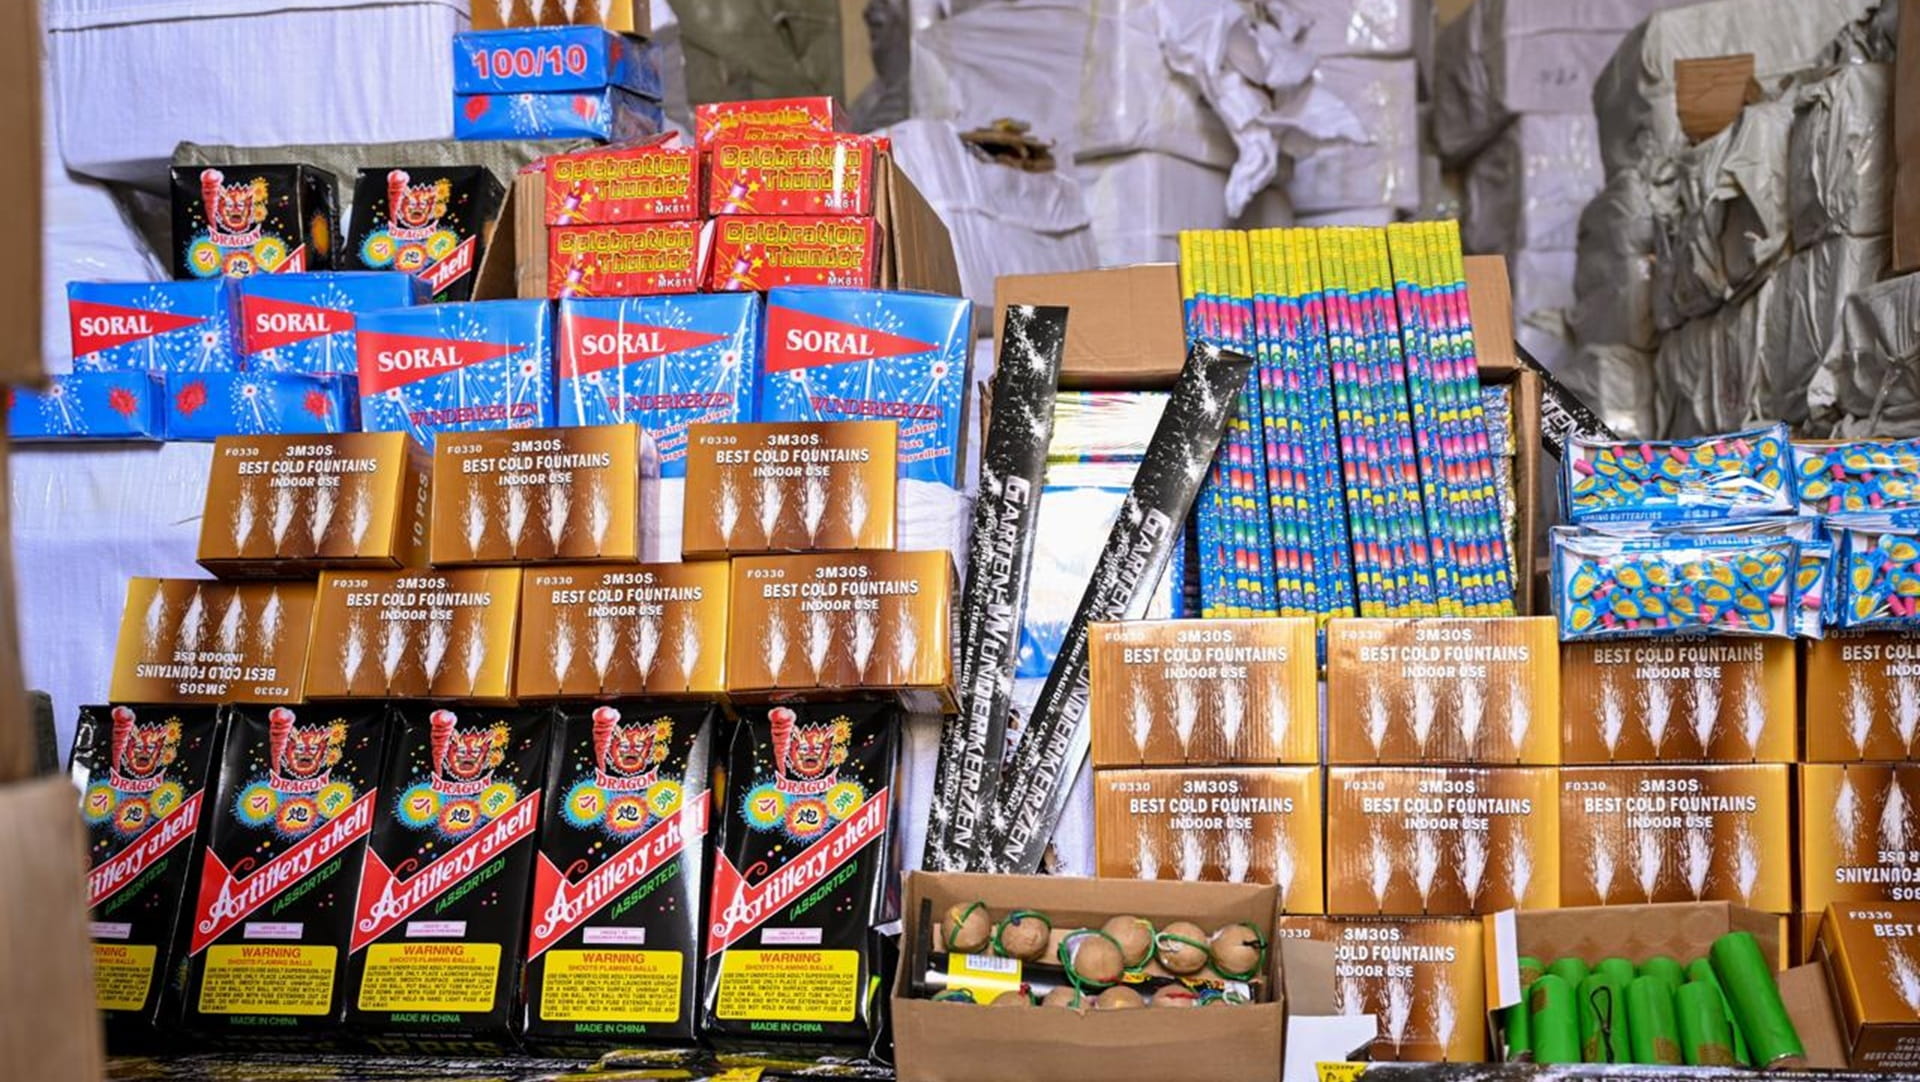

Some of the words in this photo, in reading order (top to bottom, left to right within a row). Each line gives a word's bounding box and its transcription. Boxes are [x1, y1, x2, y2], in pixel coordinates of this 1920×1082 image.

[473, 46, 587, 78] 100/10
[555, 157, 690, 180] Celebration
[597, 178, 687, 199] Thunder
[211, 230, 260, 246] DRAGON
[389, 224, 437, 239] DRAGON
[726, 223, 864, 245] Celebration
[559, 231, 693, 253] Celebration
[600, 253, 690, 273] Thunder
[767, 246, 862, 268] Thunder
[80, 316, 152, 336] SORAL
[256, 314, 330, 332] SORAL
[582, 332, 665, 355] SORAL
[786, 329, 874, 355] SORAL
[378, 347, 462, 372] SORAL
[512, 439, 562, 452] 3M30S
[768, 435, 819, 446] 3M30S
[286, 446, 333, 456] 3M30S
[716, 452, 750, 464] BEST
[753, 451, 789, 463] COLD
[793, 449, 869, 462] FOUNTAINS
[238, 461, 269, 474] BEST
[272, 460, 304, 473] COLD
[308, 459, 377, 473] FOUNTAINS
[463, 459, 495, 473] BEST
[499, 457, 532, 471] COLD
[536, 453, 610, 469] FOUNTAINS
[753, 467, 801, 477] INDOOR
[806, 466, 830, 476] USE
[270, 477, 314, 487] INDOOR
[318, 476, 340, 486] USE
[499, 474, 545, 485] INDOOR
[549, 472, 572, 483] USE
[416, 474, 429, 511] PCS
[412, 526, 425, 546] 10
[602, 573, 654, 584] 3M30S
[816, 566, 867, 578] 3M30S
[396, 578, 446, 589] 3M30S
[763, 584, 798, 598] BEST
[801, 582, 838, 596] COLD
[841, 580, 919, 595] FOUNTAINS
[347, 594, 378, 606] BEST
[382, 594, 416, 606] COLD
[420, 592, 490, 606] FOUNTAINS
[552, 590, 586, 604] BEST
[588, 590, 623, 602] COLD
[626, 587, 702, 601] FOUNTAINS
[588, 606, 636, 617] INDOOR
[638, 605, 664, 616] USE
[801, 601, 851, 611] INDOOR
[855, 599, 879, 610] USE
[381, 610, 428, 620] INDOOR
[430, 610, 453, 620] USE
[1178, 630, 1232, 643] 3M30S
[1416, 629, 1472, 641] 3M30S
[173, 651, 198, 661] USE
[200, 653, 243, 663] INDOOR
[1124, 649, 1160, 663] BEST
[1164, 649, 1201, 662] COLD
[1206, 647, 1288, 662] FOUNTAINS
[1361, 647, 1397, 662] BEST
[1401, 647, 1440, 661] COLD
[1444, 646, 1528, 661] FOUNTAINS
[1594, 650, 1630, 664] BEST
[1635, 650, 1673, 663] COLD
[1679, 647, 1763, 663] FOUNTAINS
[1843, 646, 1880, 660] BEST
[136, 664, 207, 678] FOUNTAINS
[209, 666, 241, 679] COLD
[244, 667, 277, 680] BEST
[1165, 668, 1217, 679] INDOOR
[1221, 667, 1247, 678] USE
[1402, 666, 1455, 678] INDOOR
[1459, 666, 1486, 677] USE
[1636, 667, 1690, 679] INDOOR
[1695, 667, 1721, 678] USE
[179, 683, 227, 694] 3M30S
[110, 777, 163, 791] DRAGON
[270, 777, 328, 793] DRAGON
[432, 779, 490, 794] DRAGON
[597, 774, 656, 790] DRAGON
[777, 776, 836, 793] DRAGON
[1184, 781, 1238, 793] 3M30S
[1419, 780, 1475, 793] 3M30S
[1640, 780, 1699, 792] 3M30S
[1130, 799, 1165, 813] BEST
[1169, 799, 1208, 813] COLD
[1212, 798, 1293, 813] FOUNTAINS
[1363, 799, 1400, 813] BEST
[1404, 799, 1444, 813] COLD
[1447, 799, 1531, 813] FOUNTAINS
[1585, 798, 1622, 812] BEST
[1626, 798, 1666, 812] COLD
[1671, 797, 1756, 812] FOUNTAINS
[1171, 818, 1222, 829] INDOOR
[1227, 818, 1252, 829] USE
[1405, 819, 1458, 829] INDOOR
[1462, 819, 1489, 830] USE
[1627, 817, 1683, 828] INDOOR
[1686, 817, 1713, 828] USE
[1878, 851, 1903, 862] USE
[1344, 928, 1400, 941] 3M30S
[1874, 924, 1913, 936] BEST
[242, 948, 301, 958] WARNING
[404, 946, 463, 955] WARNING
[1372, 946, 1455, 961] FOUNTAINS
[583, 953, 645, 963] WARNING
[760, 953, 821, 963] WARNING
[1387, 967, 1414, 977] USE
[575, 1024, 603, 1032] MADE
[605, 1024, 613, 1032] IN
[616, 1024, 645, 1033] CHINA
[751, 1023, 779, 1031] MADE
[781, 1023, 790, 1031] IN
[792, 1023, 822, 1032] CHINA
